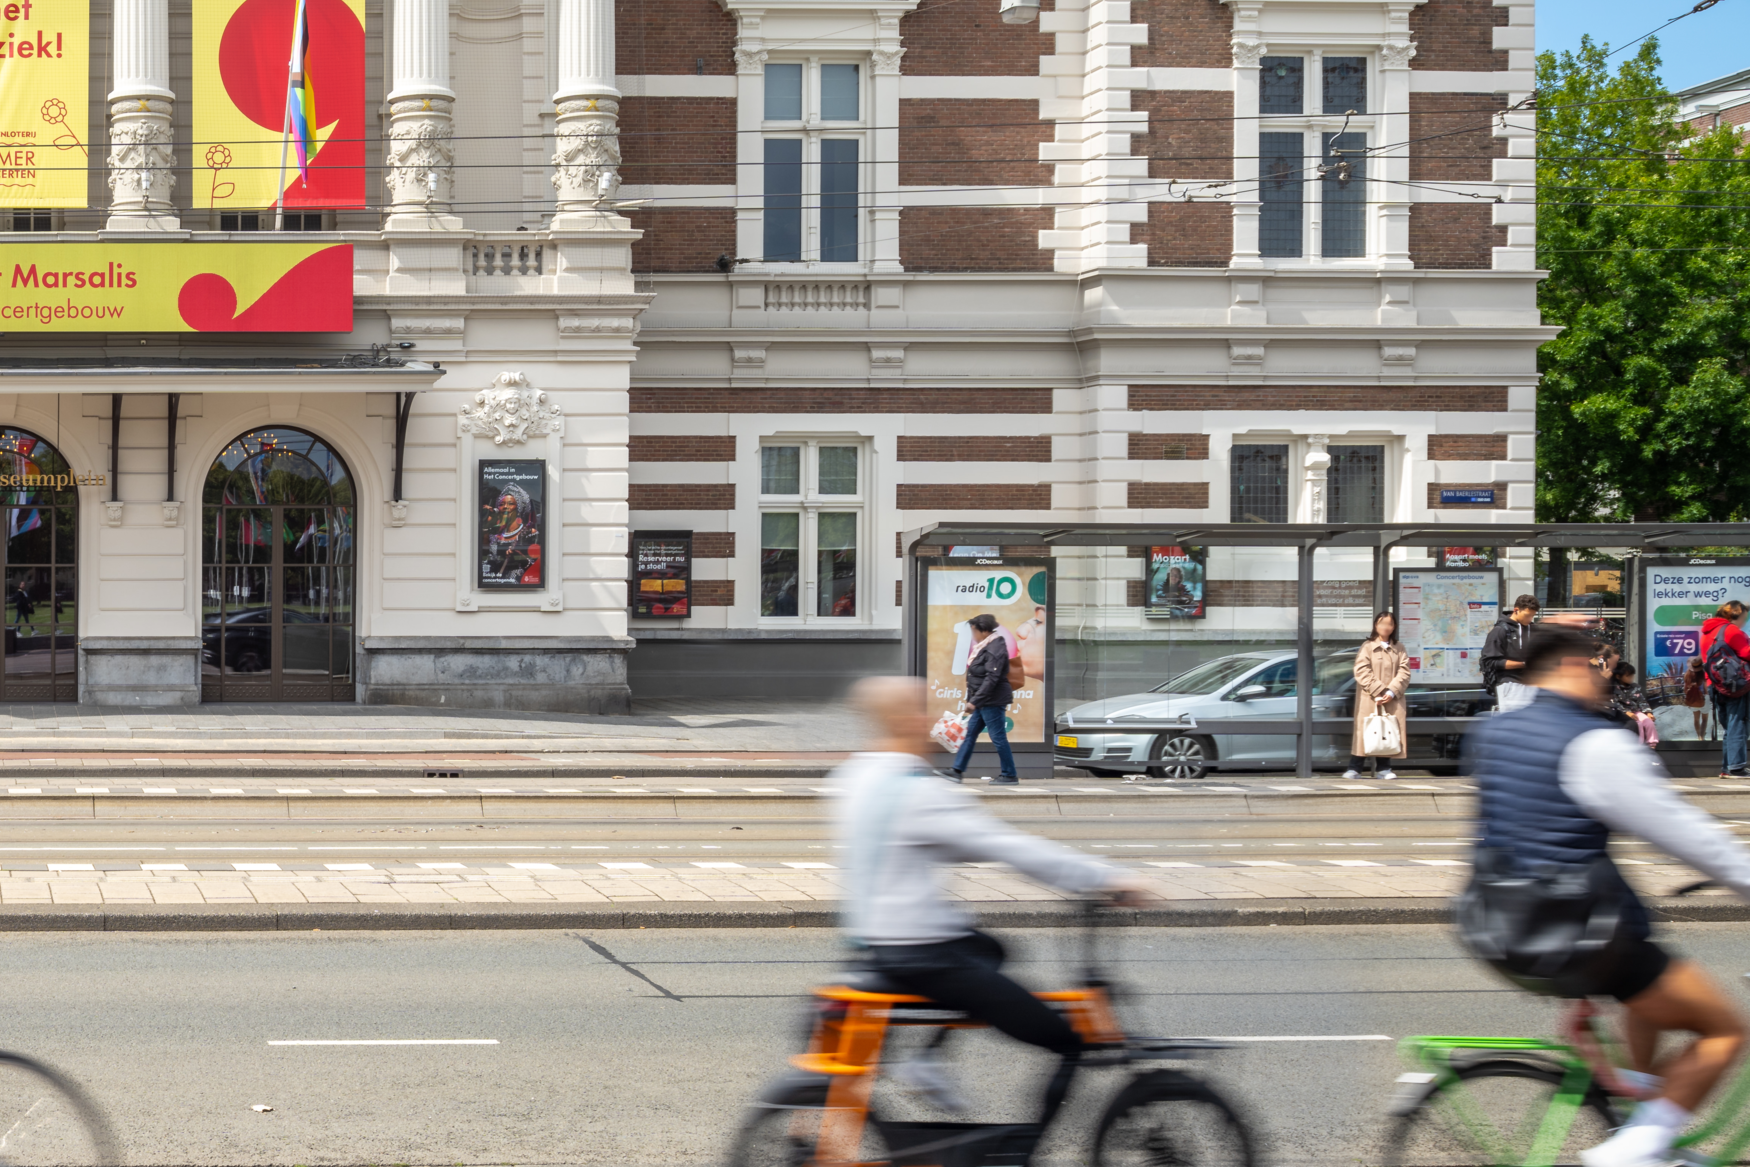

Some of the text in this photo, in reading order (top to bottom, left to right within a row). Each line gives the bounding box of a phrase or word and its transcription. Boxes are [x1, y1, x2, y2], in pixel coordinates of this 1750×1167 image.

[10, 261, 138, 289] Marsalis
[494, 473, 539, 481] Concertgebouw
[638, 554, 675, 562] Reserveer
[1152, 553, 1191, 562] Mozart
[638, 562, 667, 571] je stoel!
[1436, 574, 1485, 582] Concertgebouw
[1654, 574, 1684, 584] Deze
[1687, 576, 1726, 584] zomer
[955, 576, 1018, 600] radio 10
[1323, 580, 1359, 588] Zorg goed
[1653, 587, 1728, 602] lekker weg?
[1692, 611, 1713, 620] Pisa
[935, 686, 963, 699] Girls
